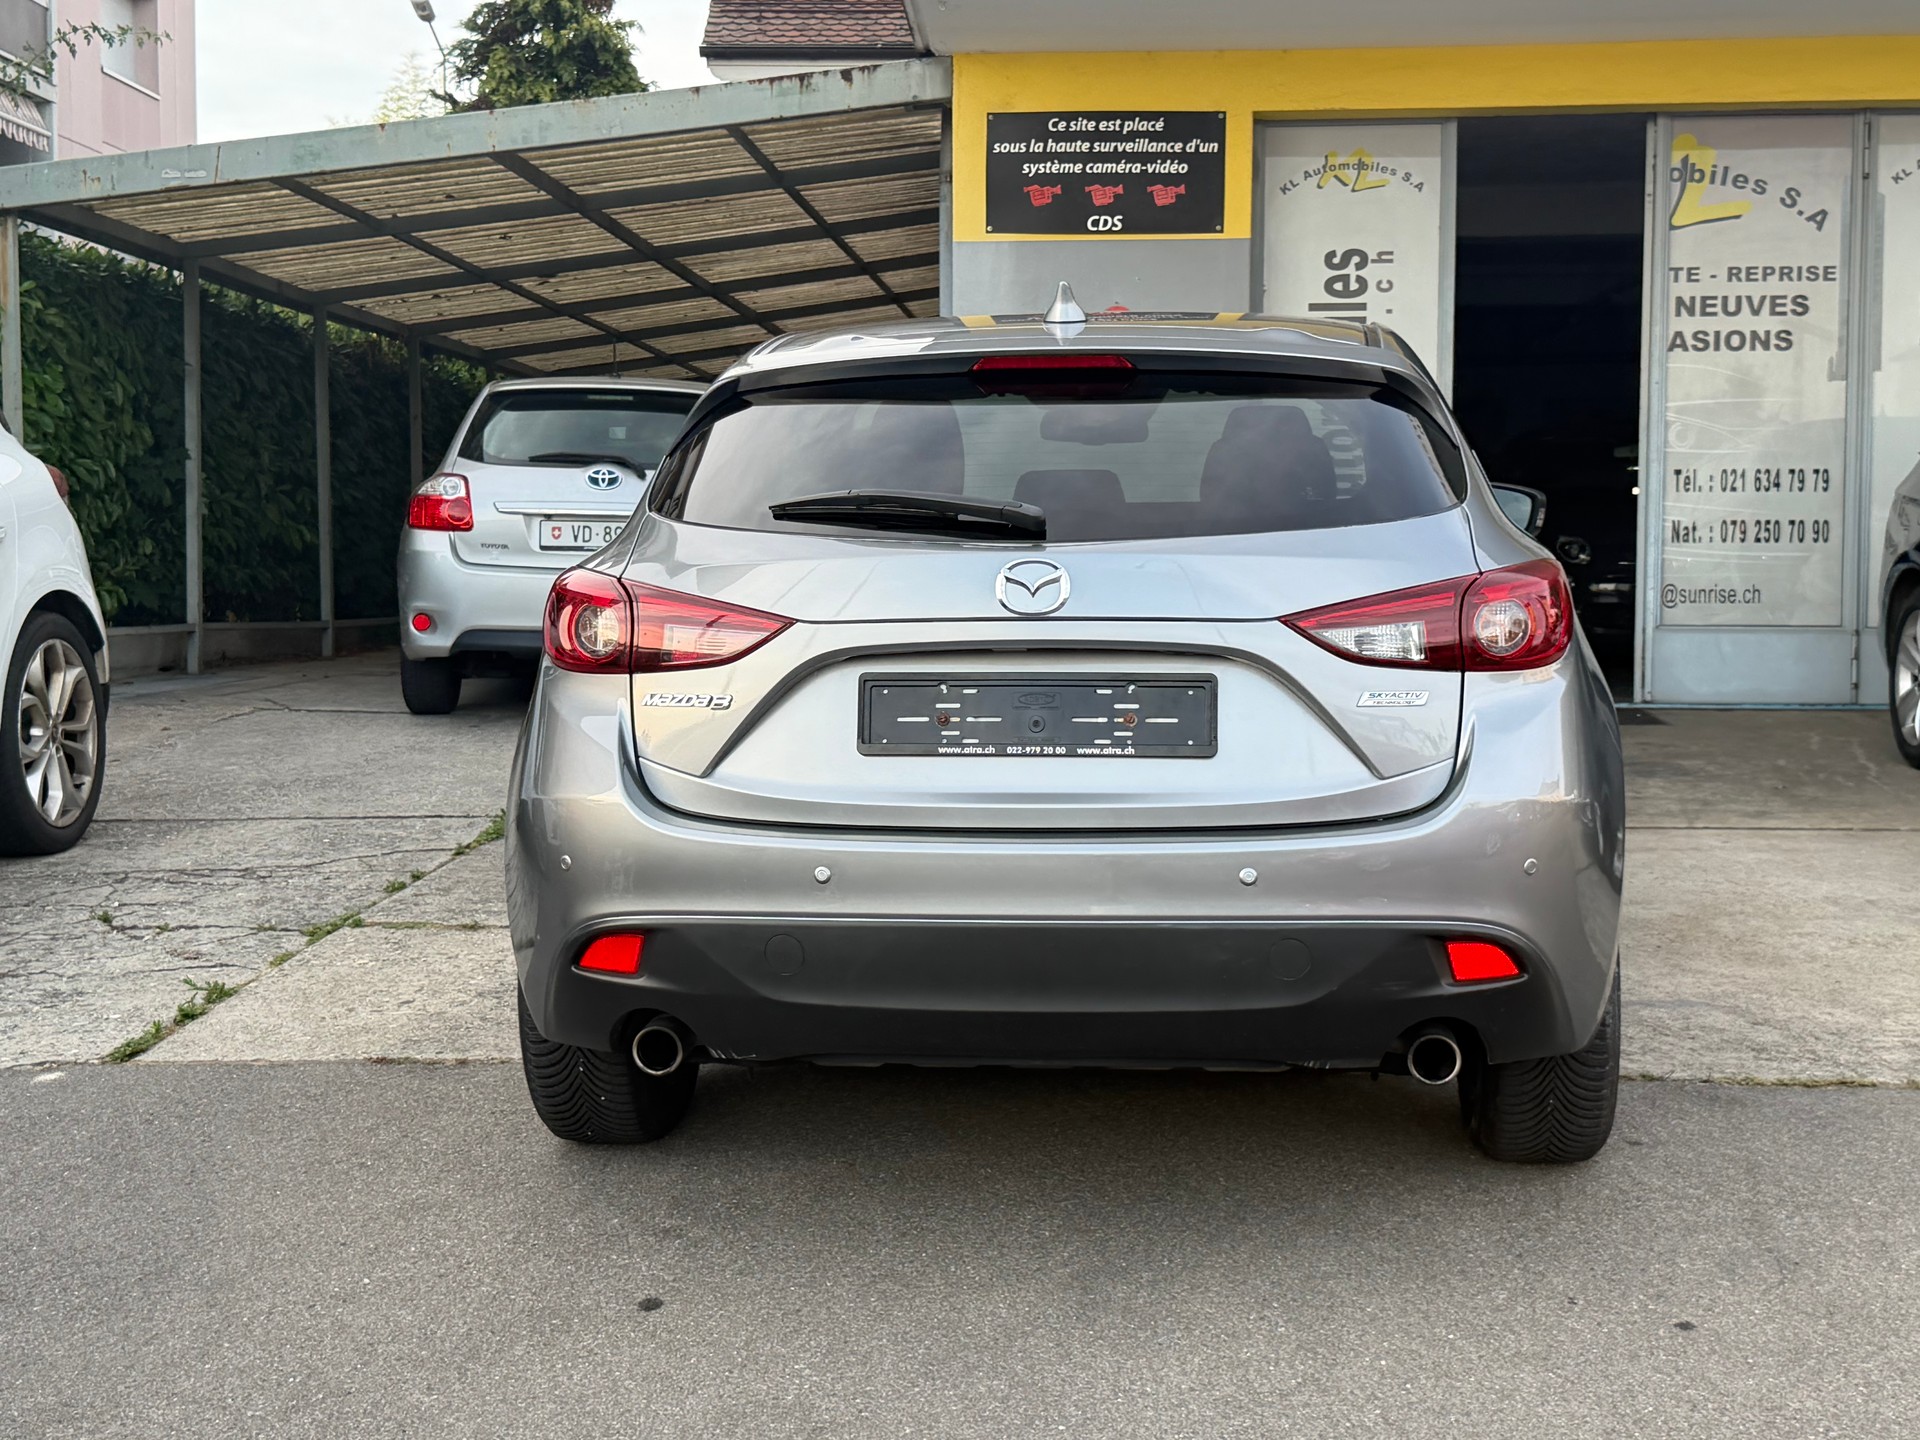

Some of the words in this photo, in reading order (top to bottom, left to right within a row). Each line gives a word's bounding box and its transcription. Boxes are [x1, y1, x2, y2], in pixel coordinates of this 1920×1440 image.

[1048, 117, 1067, 132] Ce
[1069, 117, 1096, 132] site
[1098, 119, 1121, 132] est
[1123, 117, 1165, 134] placé
[993, 141, 1027, 153] sous
[1029, 139, 1044, 153] la
[1046, 139, 1090, 153] haute
[1093, 139, 1183, 153] surveillance
[1185, 139, 1219, 153] d'un
[1021, 160, 1083, 177] système
[1086, 159, 1188, 174] caméra-vidéo
[1891, 168, 1913, 185] KL
[1279, 179, 1300, 196] KL
[1303, 161, 1398, 182] Automobiles
[1401, 172, 1425, 193] S.A
[1779, 186, 1829, 232] S.A
[1086, 215, 1123, 231] CDS
[1669, 266, 1700, 283] TE
[1727, 265, 1838, 282] REPRISE
[1674, 294, 1810, 318] NEUVES
[1667, 329, 1794, 353] ASIONS
[1673, 468, 1702, 493] Tél.
[1720, 468, 1746, 493] 021
[1754, 468, 1781, 493] 634
[1788, 468, 1805, 493] 79
[1812, 468, 1829, 493] 79
[571, 525, 592, 543] VD
[1671, 519, 1702, 543] Nat.
[1720, 519, 1746, 543] 079
[1754, 519, 1781, 543] 250
[1788, 519, 1805, 543] 70
[1812, 519, 1829, 543] 90
[1661, 583, 1761, 609] @sunrise.ch
[1006, 746, 1041, 754] 022-979
[1043, 746, 1054, 754] 20
[1055, 746, 1067, 754] 00
